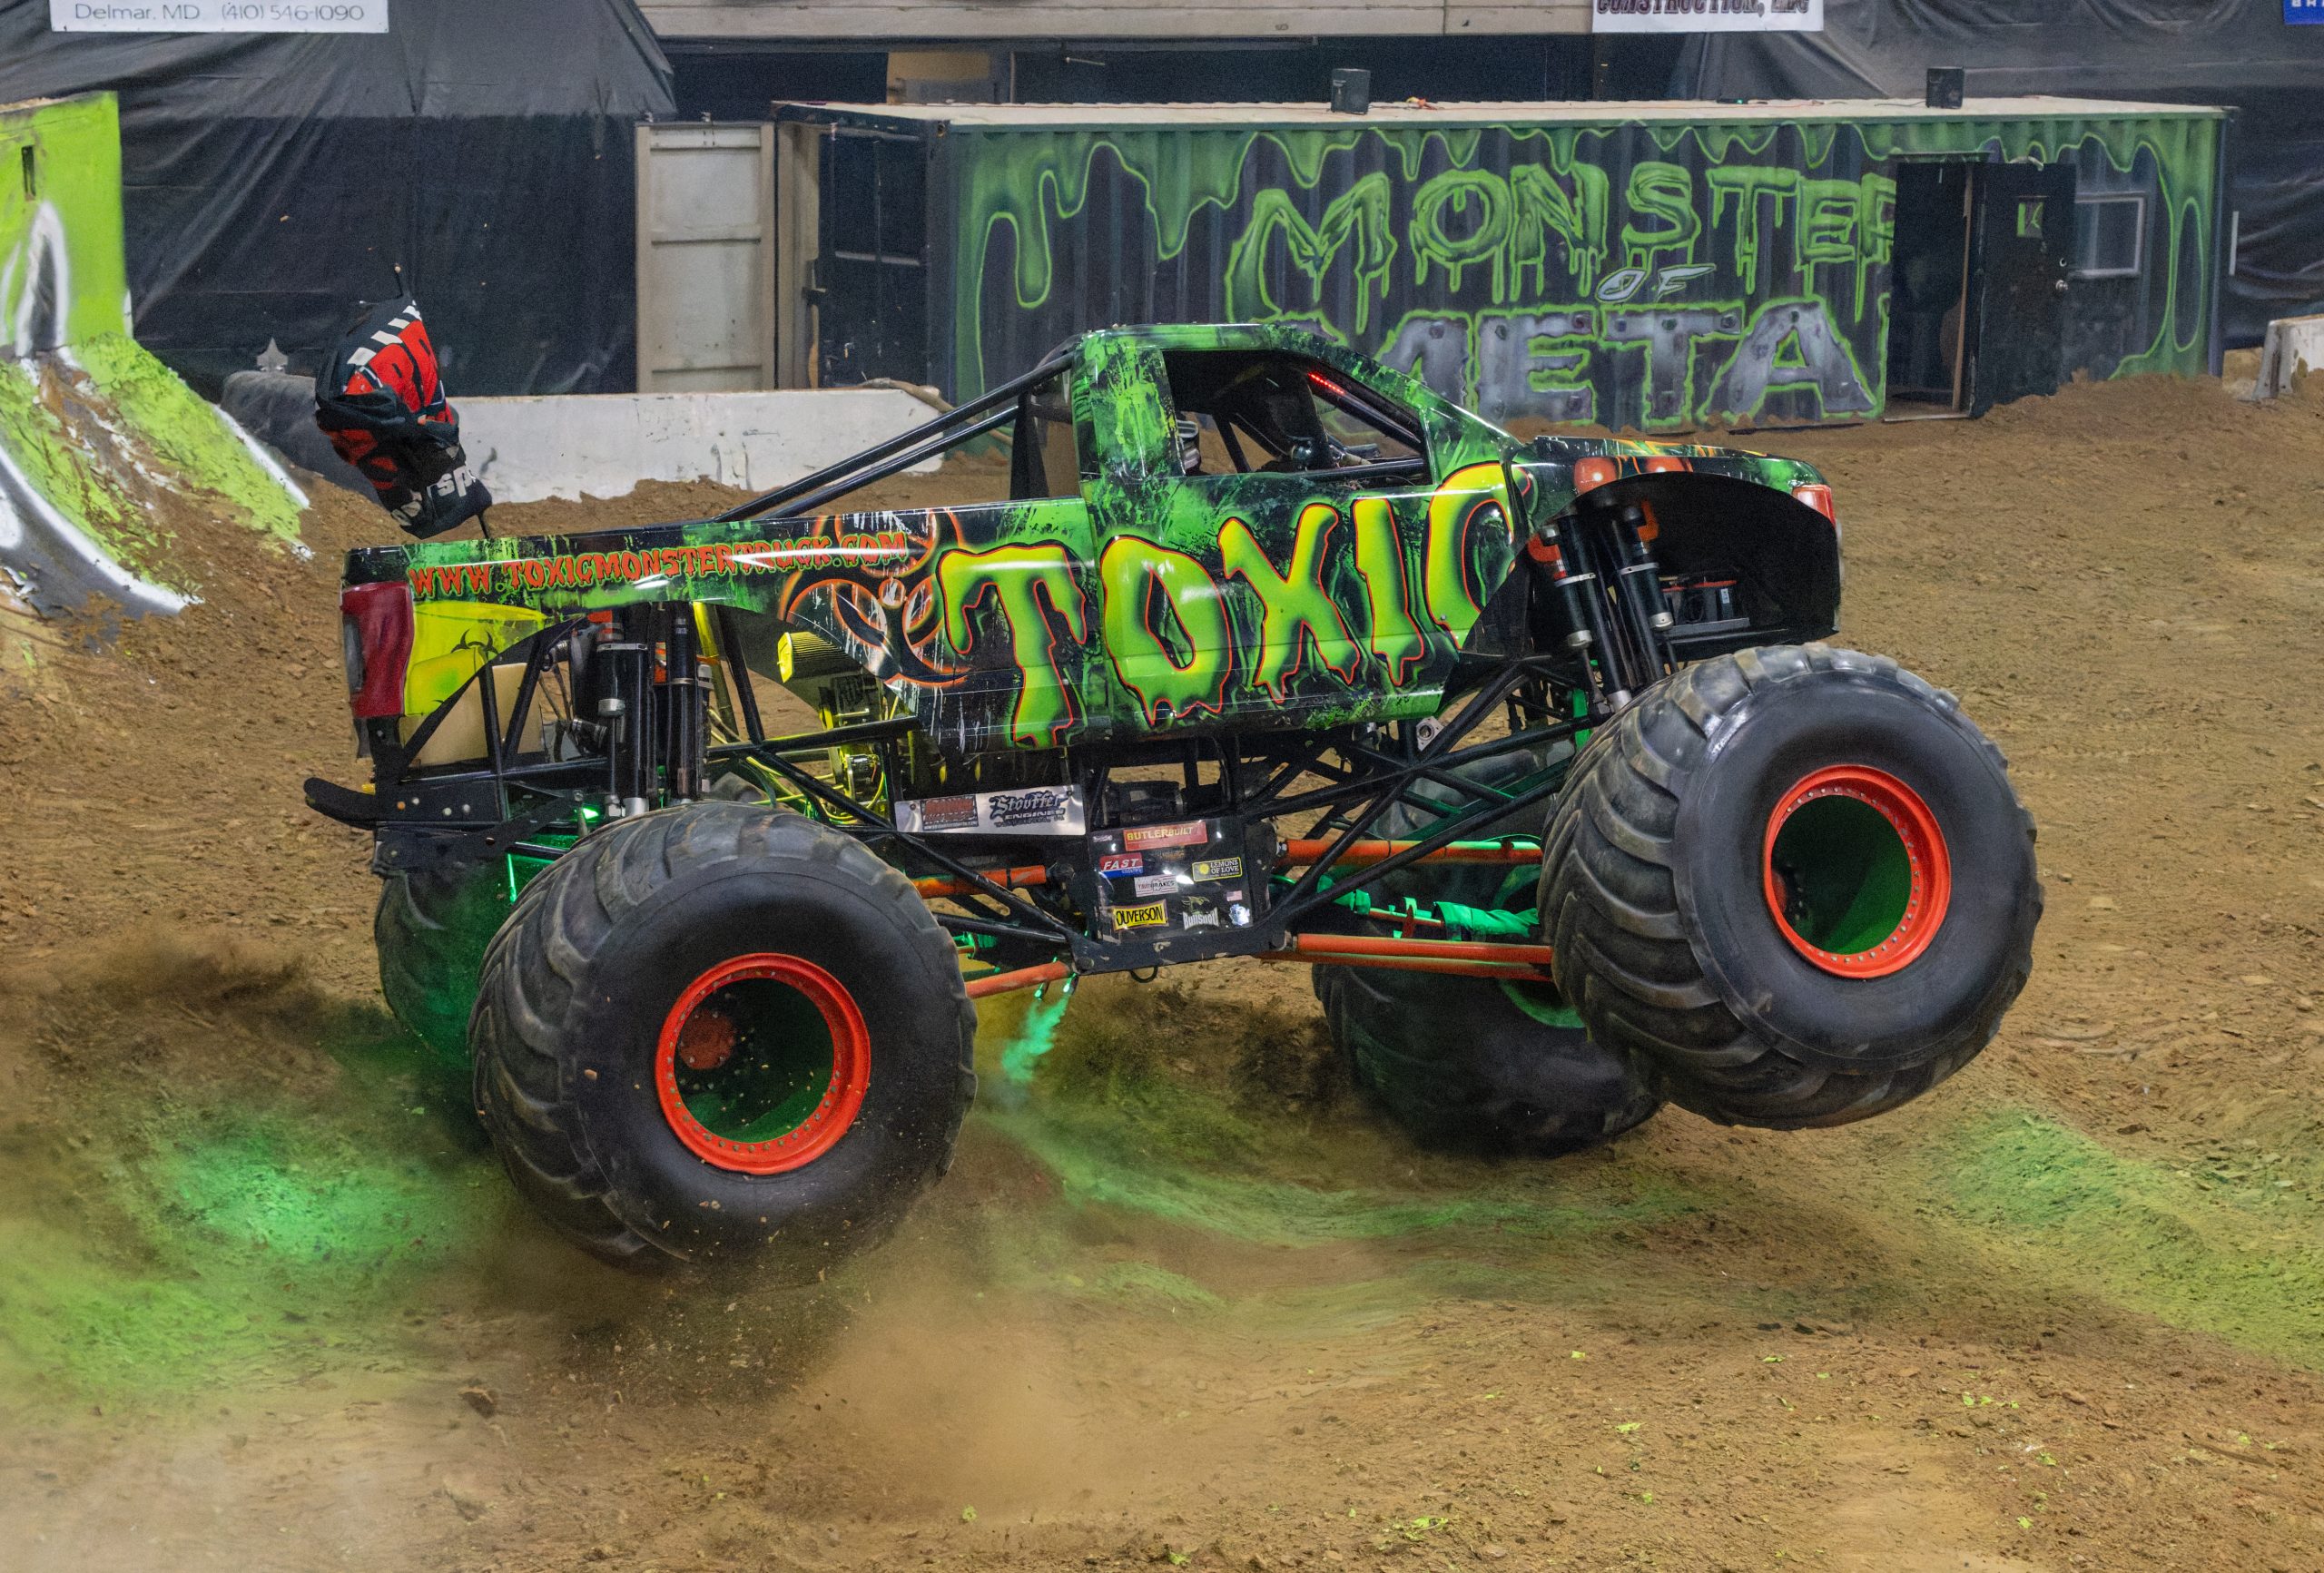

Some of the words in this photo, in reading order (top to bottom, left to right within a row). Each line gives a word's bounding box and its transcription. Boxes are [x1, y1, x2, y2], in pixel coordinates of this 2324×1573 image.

[163, 5, 200, 20] MD
[222, 4, 265, 21] (410)
[271, 5, 365, 21] 546-1090
[1595, 263, 1718, 304] OF
[409, 532, 907, 597] WWW.TOXICMONSTERTRUCK.COM
[939, 461, 1531, 747] TOXIC
[990, 791, 1067, 819] Stouffer
[1103, 858, 1140, 871] FAST
[1210, 859, 1239, 870] LEMONS
[1221, 864, 1240, 873] LOVE
[1116, 905, 1164, 926] OUVERSON
